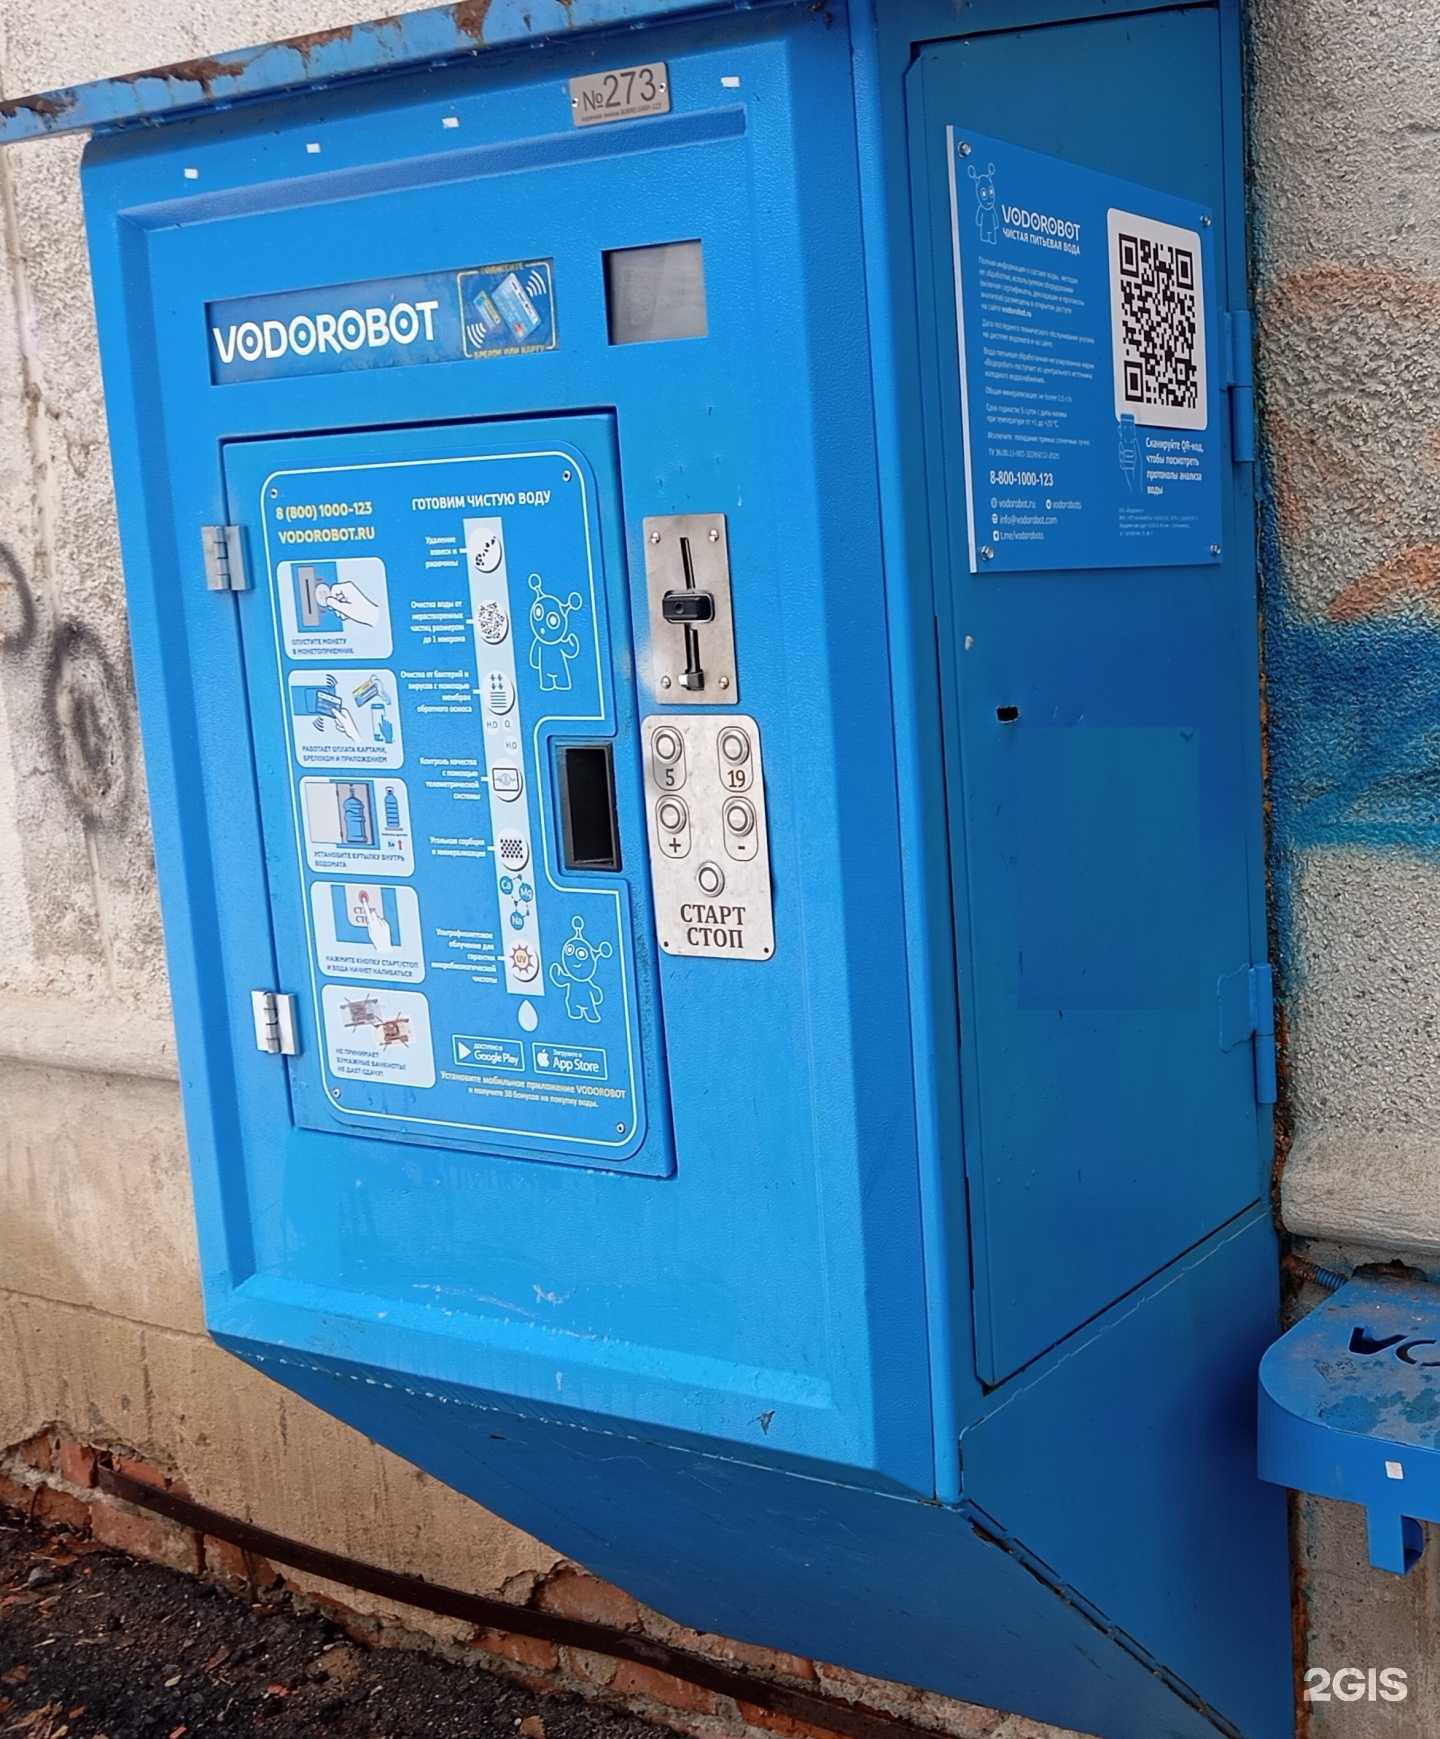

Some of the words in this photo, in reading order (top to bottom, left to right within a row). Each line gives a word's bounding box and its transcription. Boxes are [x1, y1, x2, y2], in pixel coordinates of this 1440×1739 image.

[582, 68, 656, 112] №273
[1002, 204, 1080, 241] VODOROBOT
[1002, 228, 1028, 242] ЧИСТАЯ
[1029, 235, 1062, 250] ПИТЬЕВАЯ
[1063, 243, 1080, 255] ВОДА
[213, 301, 439, 364] VODOROBOT
[1146, 454, 1164, 464] чтобы
[990, 470, 1054, 487] 8-800-1000-123
[412, 495, 465, 511] ГОТОВИМ
[468, 493, 515, 507] ЧИСТУЮ
[519, 490, 551, 506] ВОДУ
[276, 507, 284, 520] 8
[286, 506, 317, 521] (800)
[319, 502, 372, 517] 1000-123
[279, 527, 375, 544] VODOROBOT.RU
[665, 769, 675, 786] 5
[727, 770, 746, 789] 19
[680, 903, 746, 927] СТАРТ
[687, 927, 745, 950] СТОП
[474, 1051, 502, 1063] Google
[502, 1054, 519, 1066] Play
[553, 1057, 574, 1072] App
[575, 1059, 600, 1072] Store
